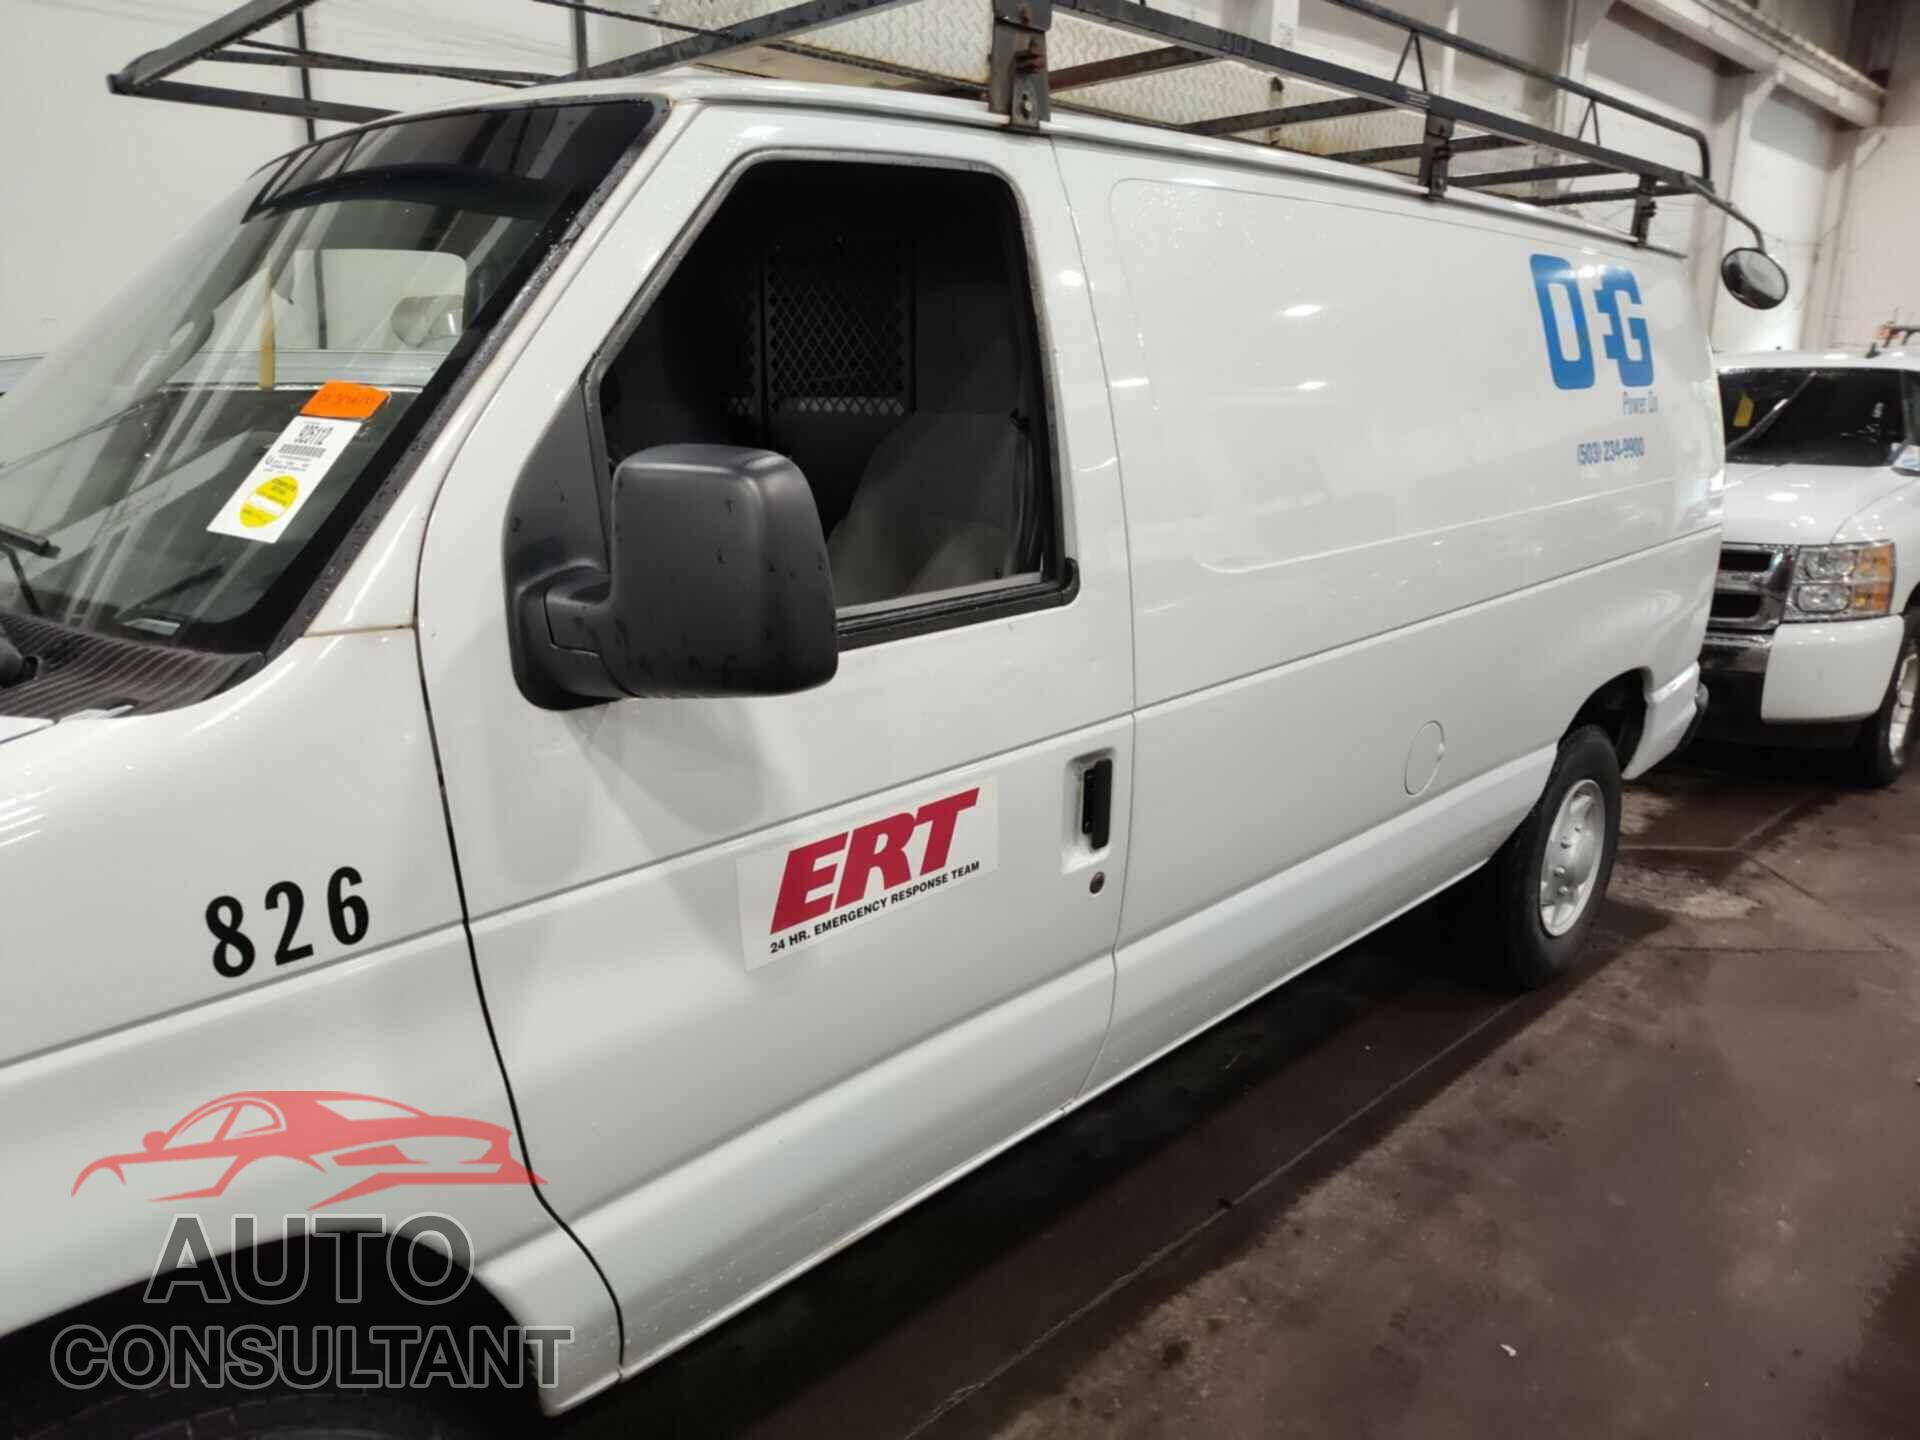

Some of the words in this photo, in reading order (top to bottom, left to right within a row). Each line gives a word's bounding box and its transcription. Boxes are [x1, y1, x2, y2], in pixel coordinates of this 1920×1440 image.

[770, 787, 980, 934] ERT
[770, 938, 785, 953] 24
[789, 931, 811, 947] HR.
[814, 898, 887, 936] EMERGENCY
[891, 873, 948, 904] RESPONSE
[951, 861, 980, 880] TEAM
[205, 866, 370, 978] 826
